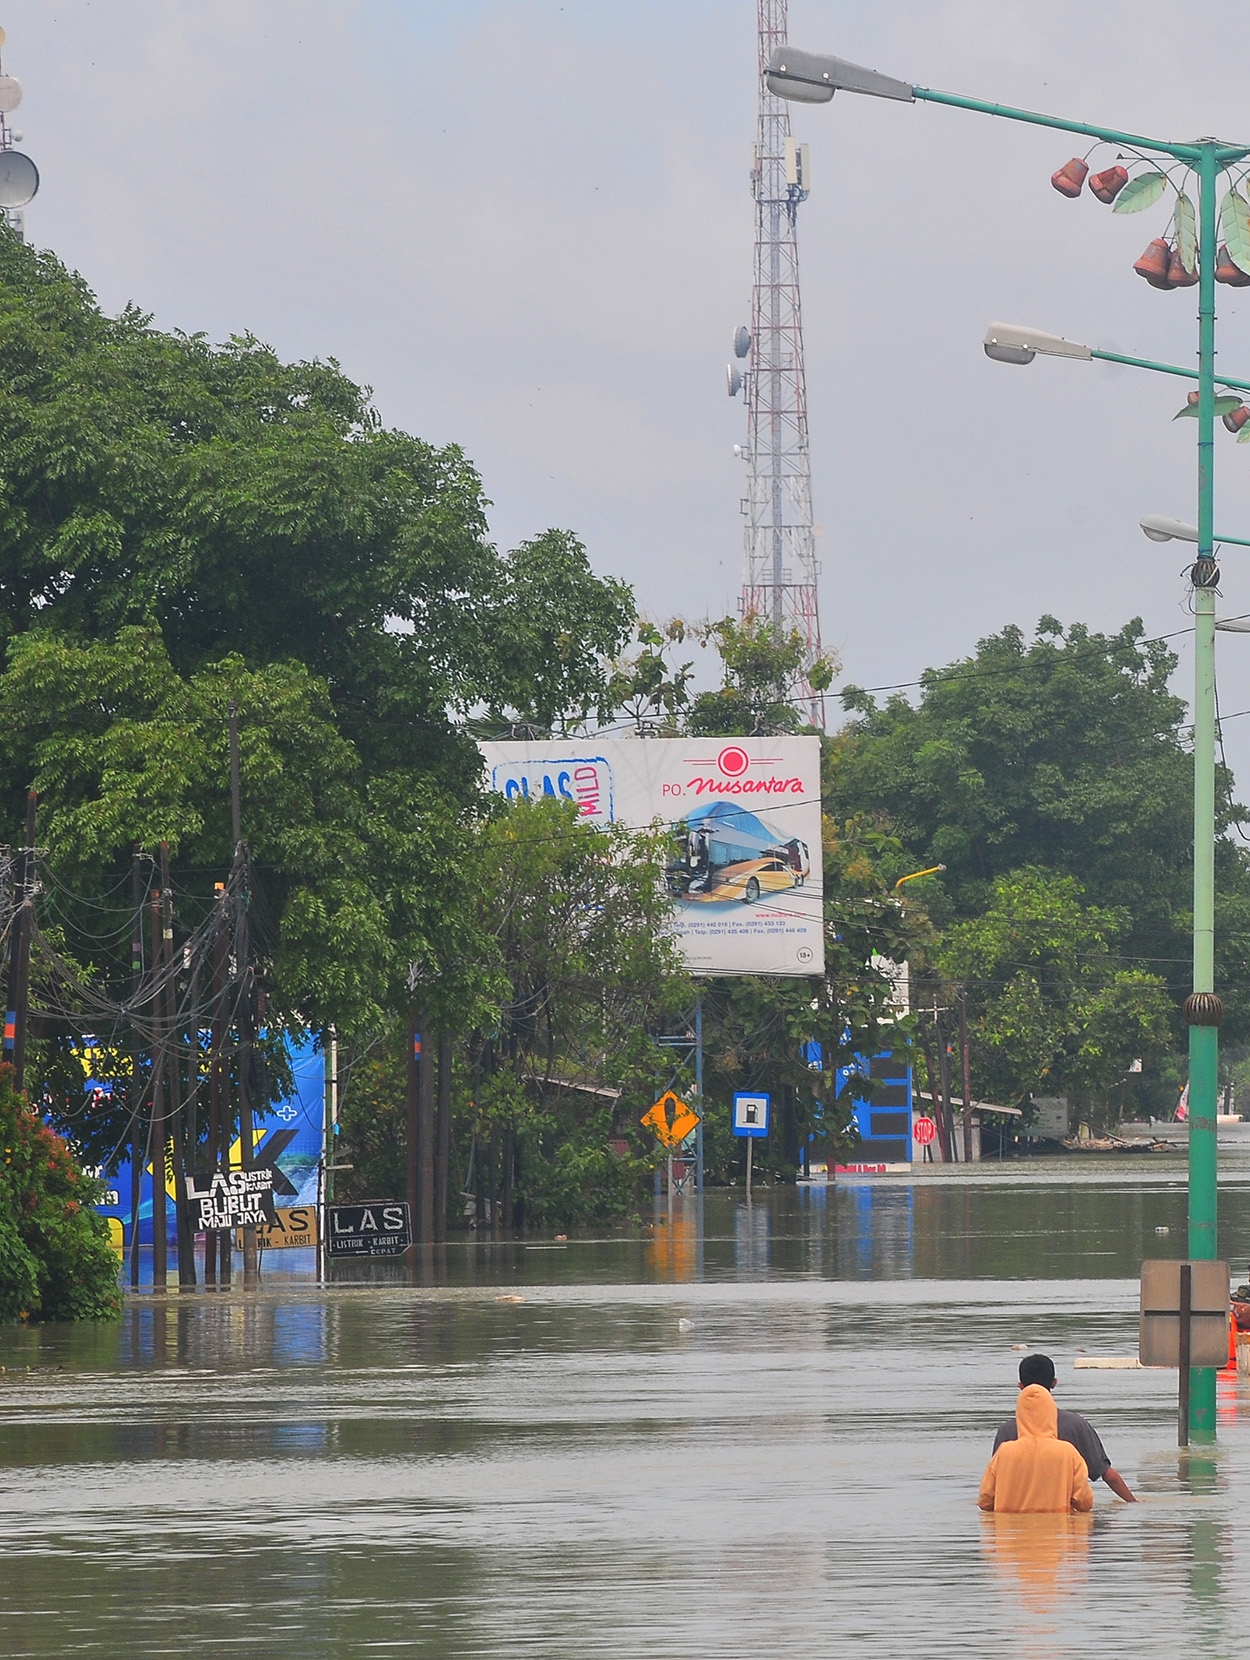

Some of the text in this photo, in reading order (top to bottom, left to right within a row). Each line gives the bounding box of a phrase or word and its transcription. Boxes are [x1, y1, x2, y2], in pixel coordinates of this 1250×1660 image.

[662, 784, 686, 796] PO.
[916, 1121, 932, 1143] STOP
[185, 1171, 246, 1200] LAS
[246, 1181, 273, 1192] KARBIT
[200, 1193, 262, 1218] BUBUT
[199, 1210, 267, 1230] MAJU JAYA
[256, 1210, 309, 1234] AS
[334, 1207, 404, 1234] LAS
[284, 1234, 311, 1246] KARBIT
[336, 1236, 399, 1249] LISTRIK KARBIT
[370, 1247, 396, 1255] CEPAT
